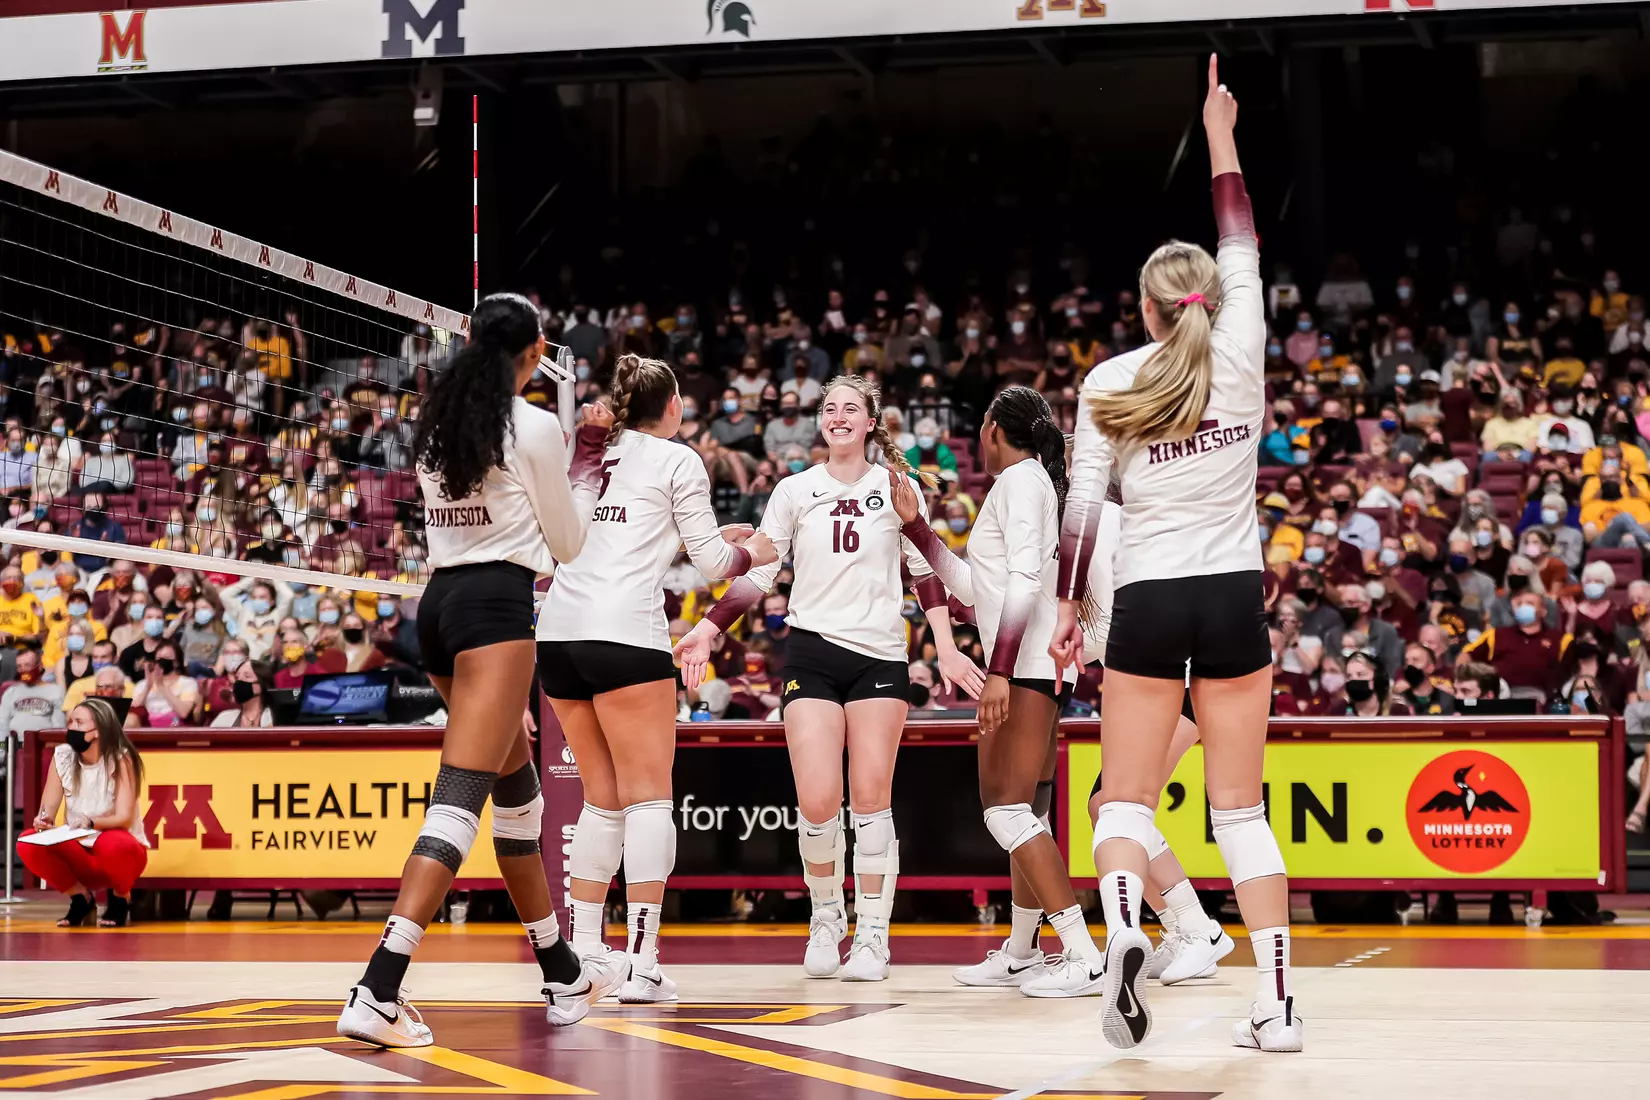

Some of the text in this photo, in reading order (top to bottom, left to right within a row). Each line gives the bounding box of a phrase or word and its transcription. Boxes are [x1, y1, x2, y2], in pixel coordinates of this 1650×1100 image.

[98, 11, 148, 64] M
[381, 0, 464, 57] M
[1147, 424, 1251, 465] MINNESOTA
[833, 520, 860, 554] 16
[252, 783, 431, 819] HEALTH
[680, 795, 730, 831] for
[738, 805, 800, 841] you
[251, 830, 377, 850] FAIRVIEW
[1424, 824, 1513, 836] MINNESOTA
[1432, 837, 1506, 849] LOTTERY
